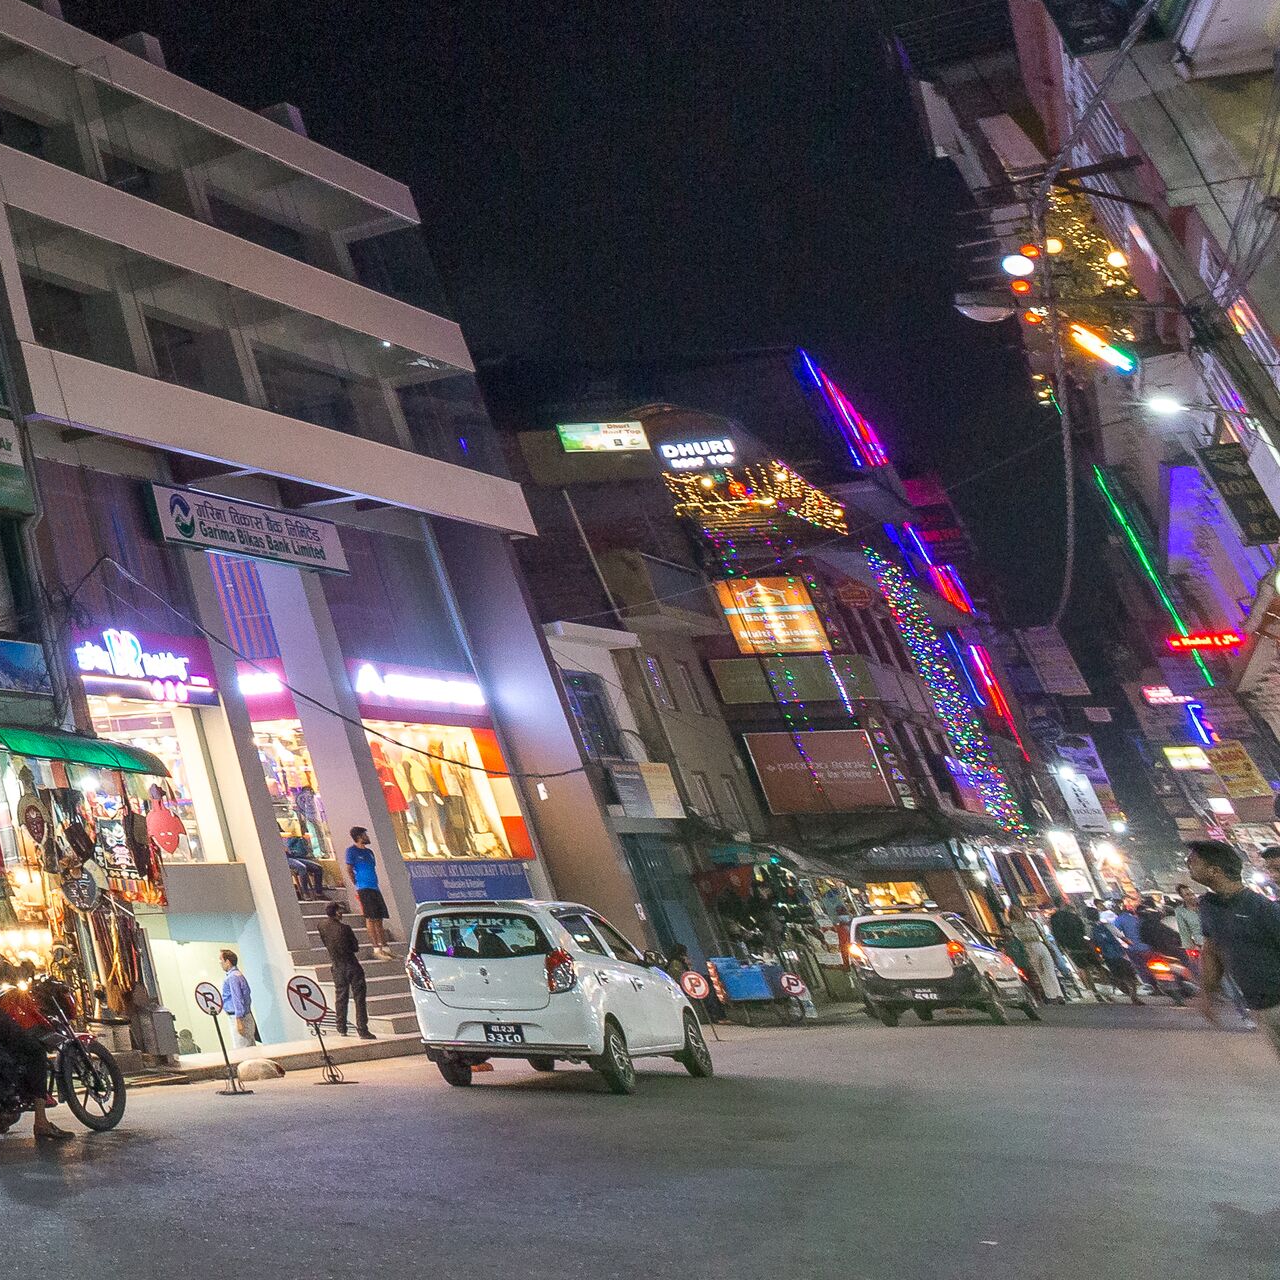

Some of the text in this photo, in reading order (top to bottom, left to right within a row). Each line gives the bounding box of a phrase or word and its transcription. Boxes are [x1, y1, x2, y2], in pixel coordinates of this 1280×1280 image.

[661, 438, 736, 459] DHURI
[199, 522, 327, 561] Garima Bikas Bank Limited
[487, 1033, 522, 1043] ३३८०
